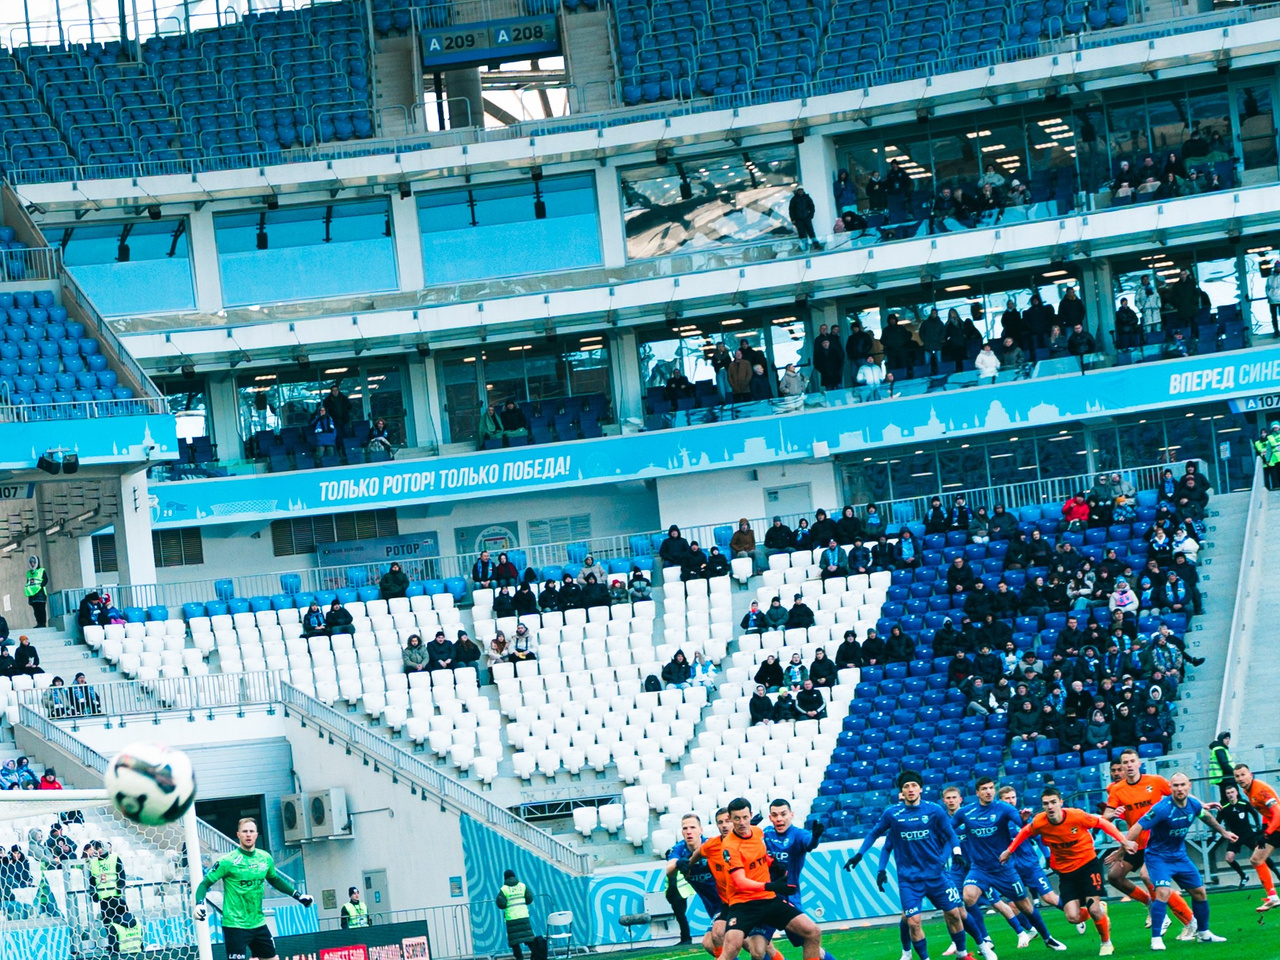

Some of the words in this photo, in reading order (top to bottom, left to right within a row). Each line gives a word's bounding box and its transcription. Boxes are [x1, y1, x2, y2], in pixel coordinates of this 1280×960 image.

[429, 38, 441, 51] A
[445, 34, 476, 50] 209
[497, 29, 510, 43] A
[512, 25, 544, 42] 208
[1169, 365, 1235, 395] ВПЕРЕД
[1247, 398, 1257, 409] A
[319, 476, 379, 502] ТОЛЬКО
[382, 471, 435, 496] РОТОР!
[439, 463, 499, 490] ТОЛЬКО
[503, 455, 571, 482] ПОБЕДА!
[385, 543, 420, 556] РОТОР
